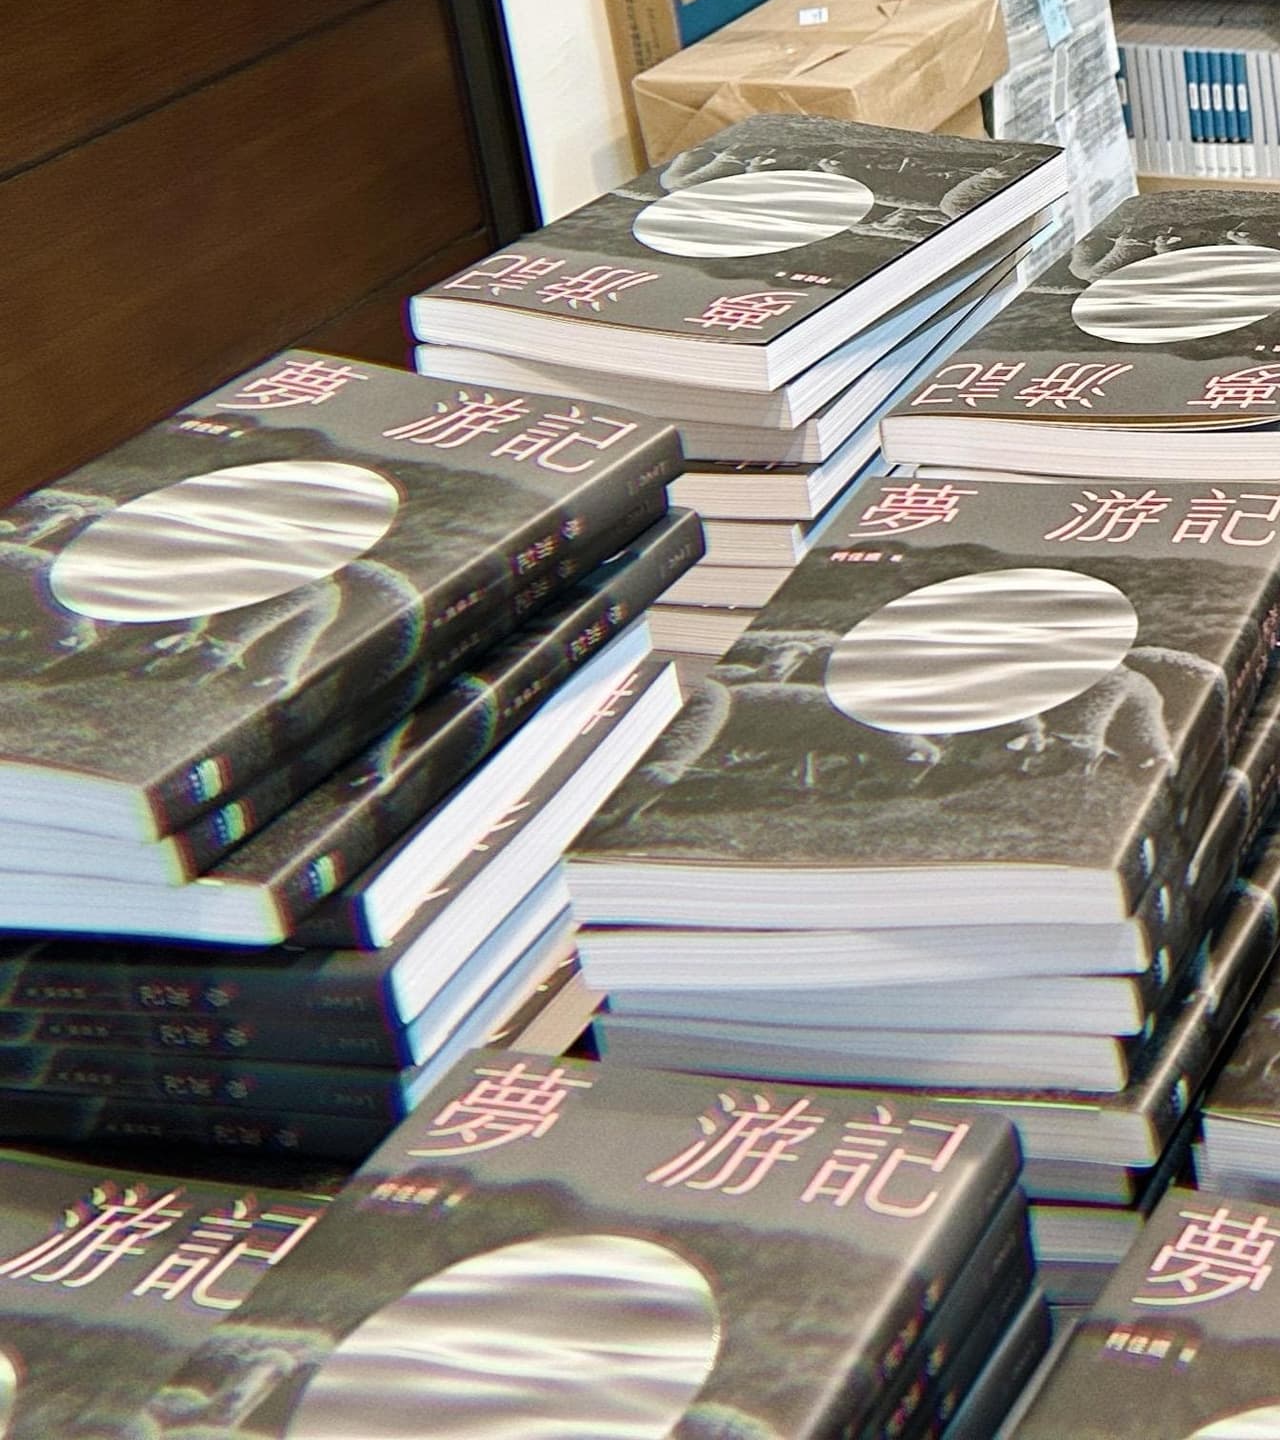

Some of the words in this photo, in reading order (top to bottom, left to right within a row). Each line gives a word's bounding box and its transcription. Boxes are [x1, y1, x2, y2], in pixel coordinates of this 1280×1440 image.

[443, 253, 660, 312] 游記
[684, 291, 810, 332] 夢
[911, 361, 1133, 409] 游記
[215, 358, 369, 411] 夢
[382, 389, 638, 474] 游記
[849, 483, 978, 538] 夢
[407, 1062, 594, 1158] 夢
[645, 1093, 972, 1220] 游記
